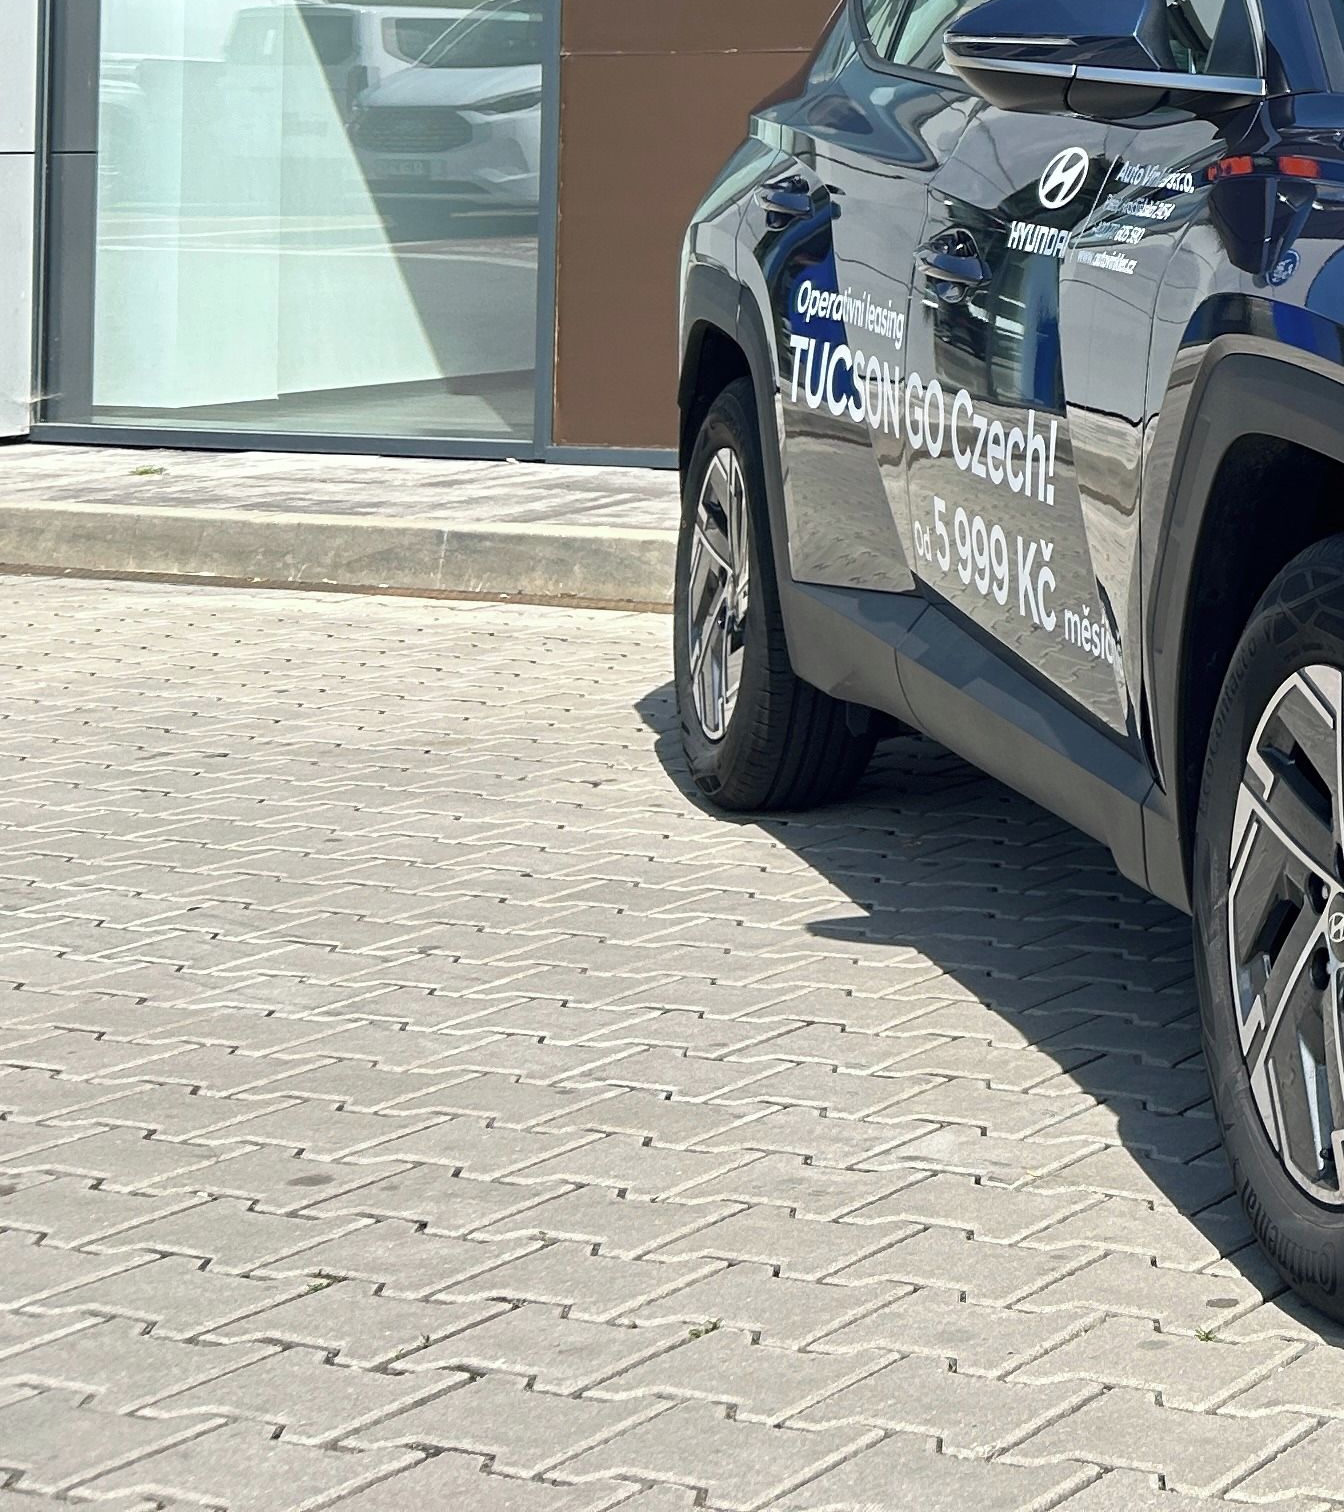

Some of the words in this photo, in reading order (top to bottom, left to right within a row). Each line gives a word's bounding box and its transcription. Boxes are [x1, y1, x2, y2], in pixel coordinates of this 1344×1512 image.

[1114, 160, 1145, 186] Auto
[1007, 220, 1072, 260] HYUNDAI
[797, 280, 866, 329] Operativní
[864, 293, 905, 350] leasing
[789, 334, 900, 439] TUCSON
[905, 372, 945, 458] GO
[951, 388, 1058, 506] Czech!
[914, 520, 932, 562] Od
[954, 506, 1009, 606] 999
[1017, 535, 1058, 632] Kč
